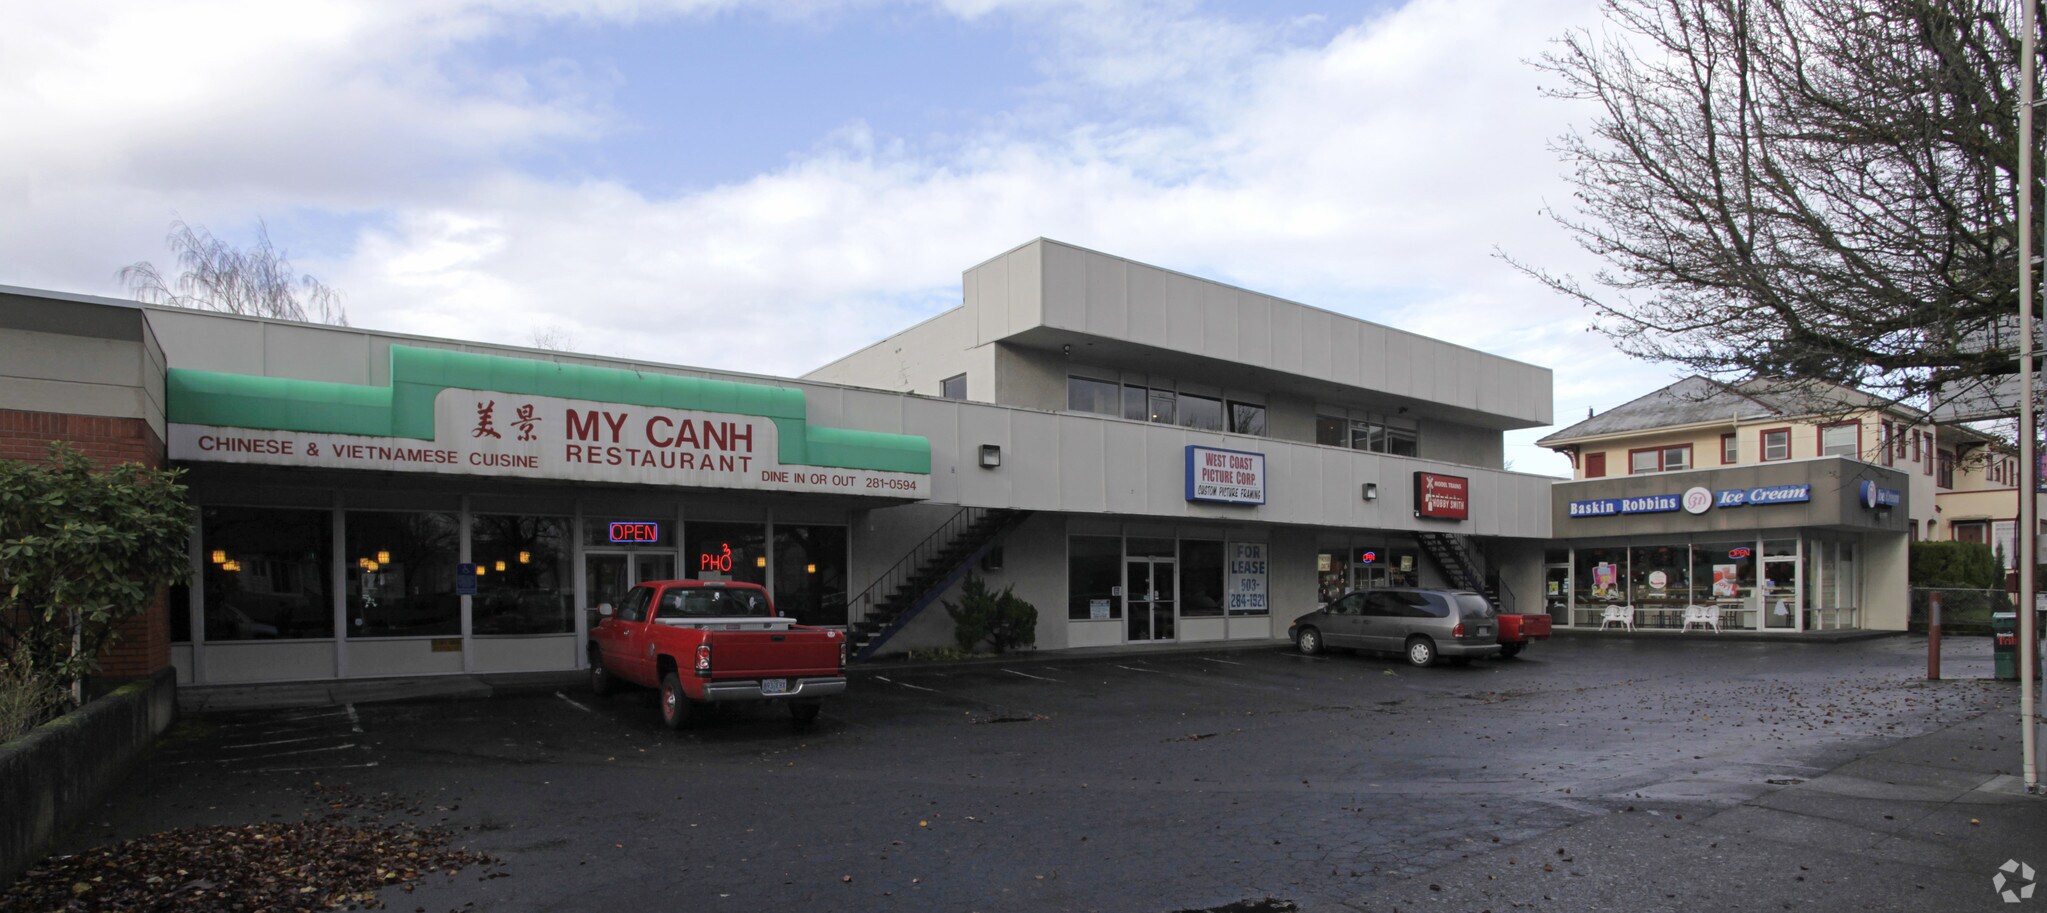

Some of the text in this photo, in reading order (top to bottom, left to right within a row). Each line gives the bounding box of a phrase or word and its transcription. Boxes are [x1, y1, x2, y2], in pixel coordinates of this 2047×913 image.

[471, 400, 542, 442] 美景
[566, 409, 752, 453] MY CANH
[198, 435, 539, 469] CHINESE & VIETNAMESE CUISINE
[566, 444, 752, 473] RESTAURANT
[1205, 452, 1253, 471] WEST COAST
[761, 470, 917, 491] DINE IN OR OUT 281-0594
[1202, 467, 1256, 486] PICTURE CORP.
[1197, 484, 1261, 500] CUSTOM PICTURE FRAMING
[1720, 488, 1806, 504] Ice Cream
[1450, 500, 1465, 510] SMITH
[1570, 496, 1677, 515] Baskin Robbins
[611, 523, 657, 541] OPEN
[1237, 545, 1260, 558] FOR
[1728, 548, 1751, 558] OPEN
[1231, 561, 1265, 574] LEASE
[1241, 579, 1260, 592] 503-
[1230, 593, 1266, 608] 284-1921
